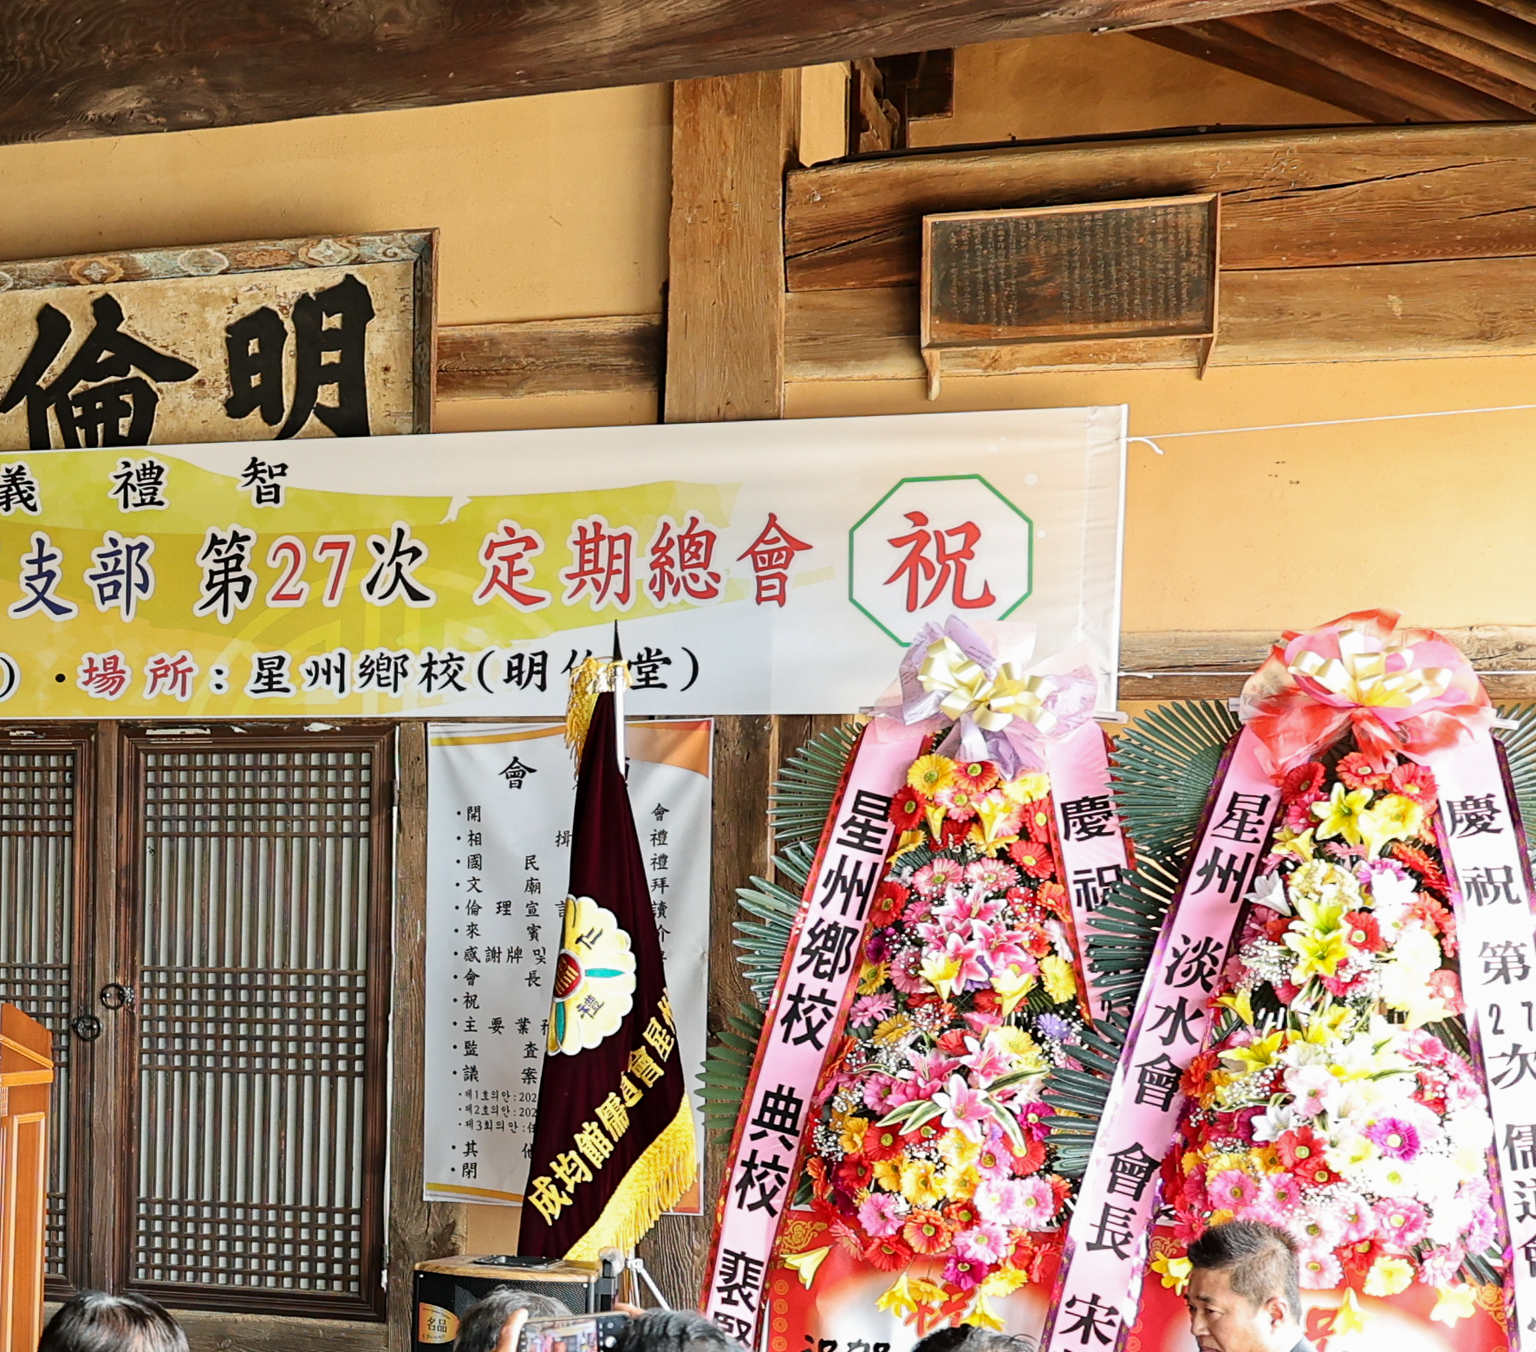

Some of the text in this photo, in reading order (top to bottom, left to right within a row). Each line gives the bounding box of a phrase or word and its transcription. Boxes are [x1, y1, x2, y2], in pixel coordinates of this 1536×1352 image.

[112, 459, 167, 509] 禮
[241, 457, 288, 504] 智
[194, 525, 431, 616] 第27次
[477, 511, 812, 608] 定期總會
[885, 509, 996, 612] 祝
[1195, 793, 1271, 904] 星州
[1446, 794, 1520, 905] 慶祝
[1133, 934, 1226, 1112] 淡水會
[733, 1085, 809, 1219] 典校
[1086, 1140, 1159, 1262] 會長
